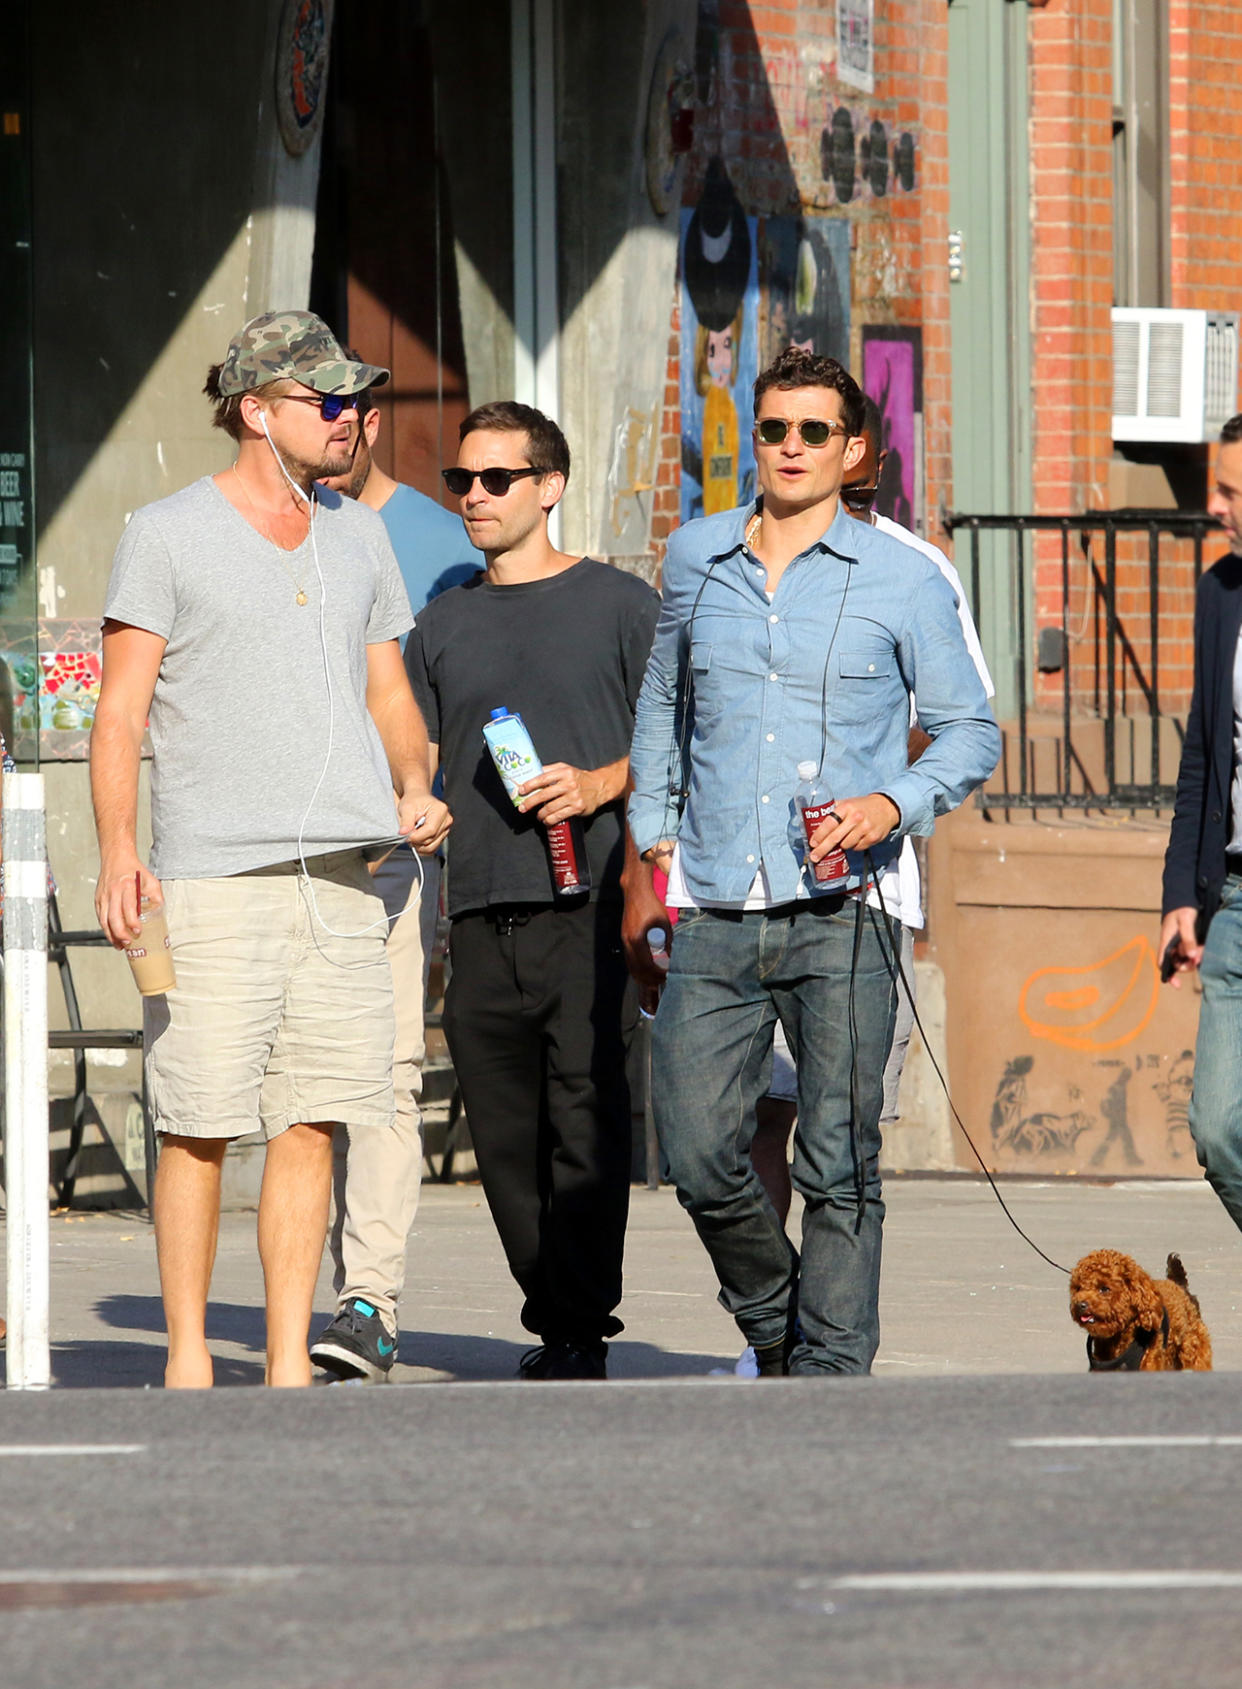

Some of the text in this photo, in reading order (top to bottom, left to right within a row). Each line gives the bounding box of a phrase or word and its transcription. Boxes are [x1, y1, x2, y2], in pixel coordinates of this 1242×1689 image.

[1, 471, 20, 497] BEER
[495, 751, 522, 765] VITA
[804, 810, 820, 820] the
